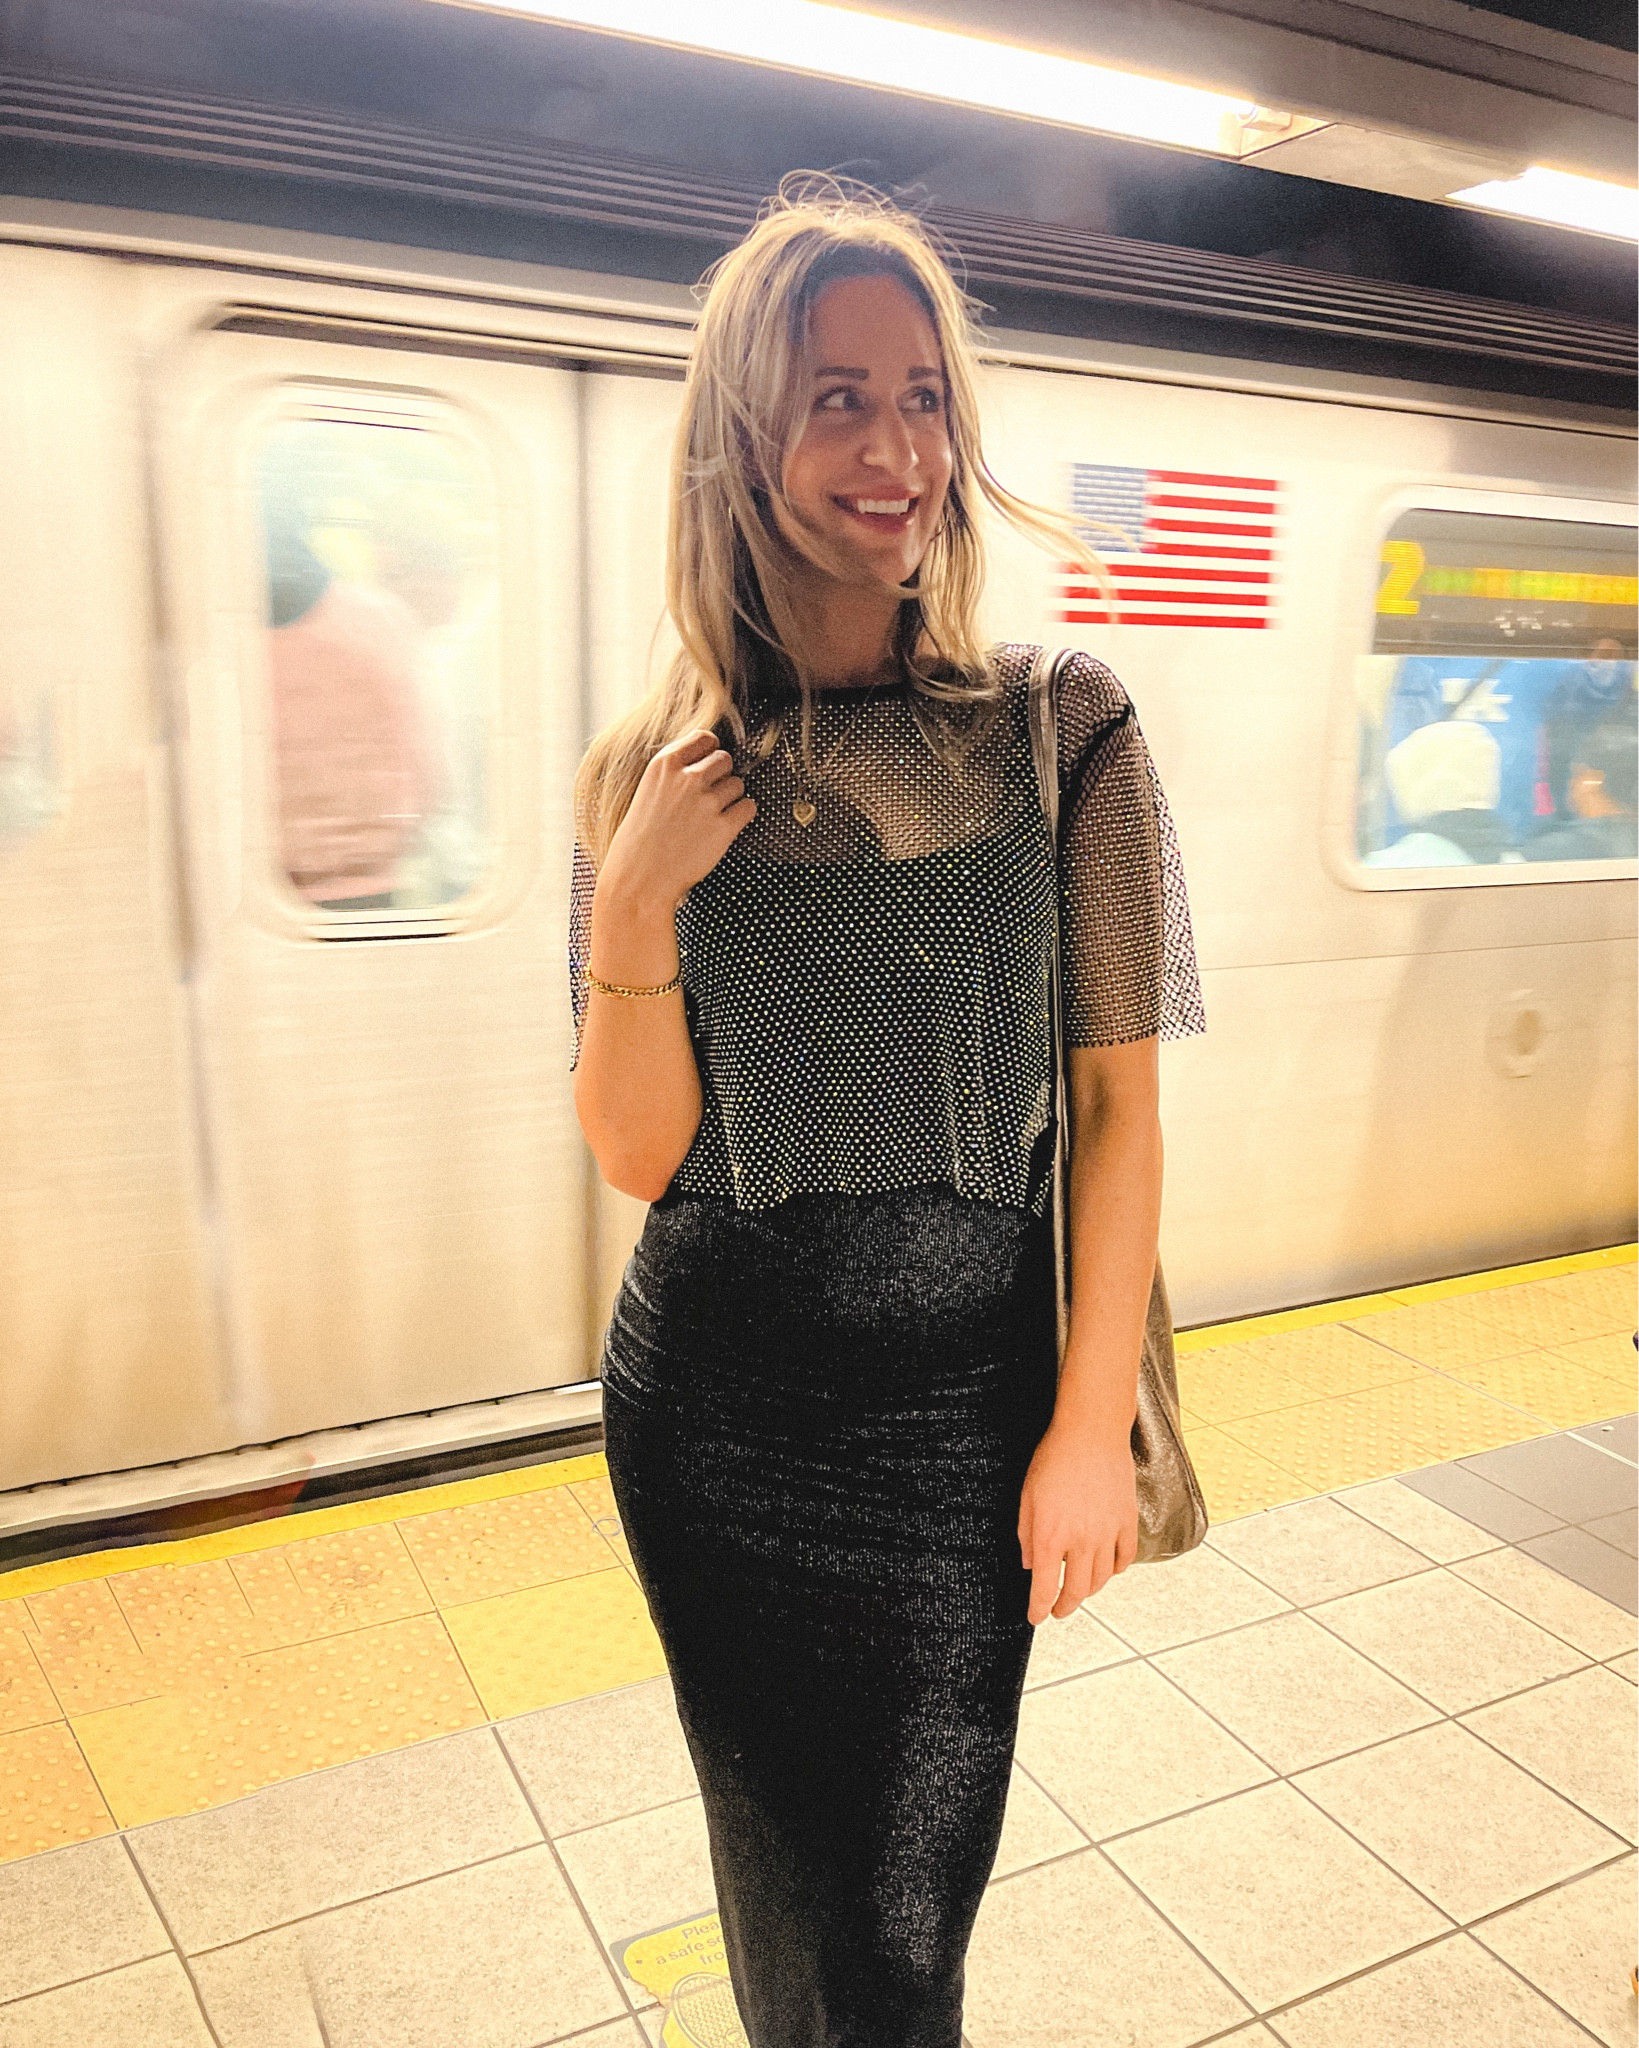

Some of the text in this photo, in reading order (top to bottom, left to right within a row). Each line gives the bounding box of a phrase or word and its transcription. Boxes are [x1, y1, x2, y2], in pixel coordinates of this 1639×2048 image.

[1375, 540, 1424, 615] 2
[682, 1921, 719, 1939] Plea
[656, 1955, 666, 1965] a
[668, 1942, 704, 1960] safe
